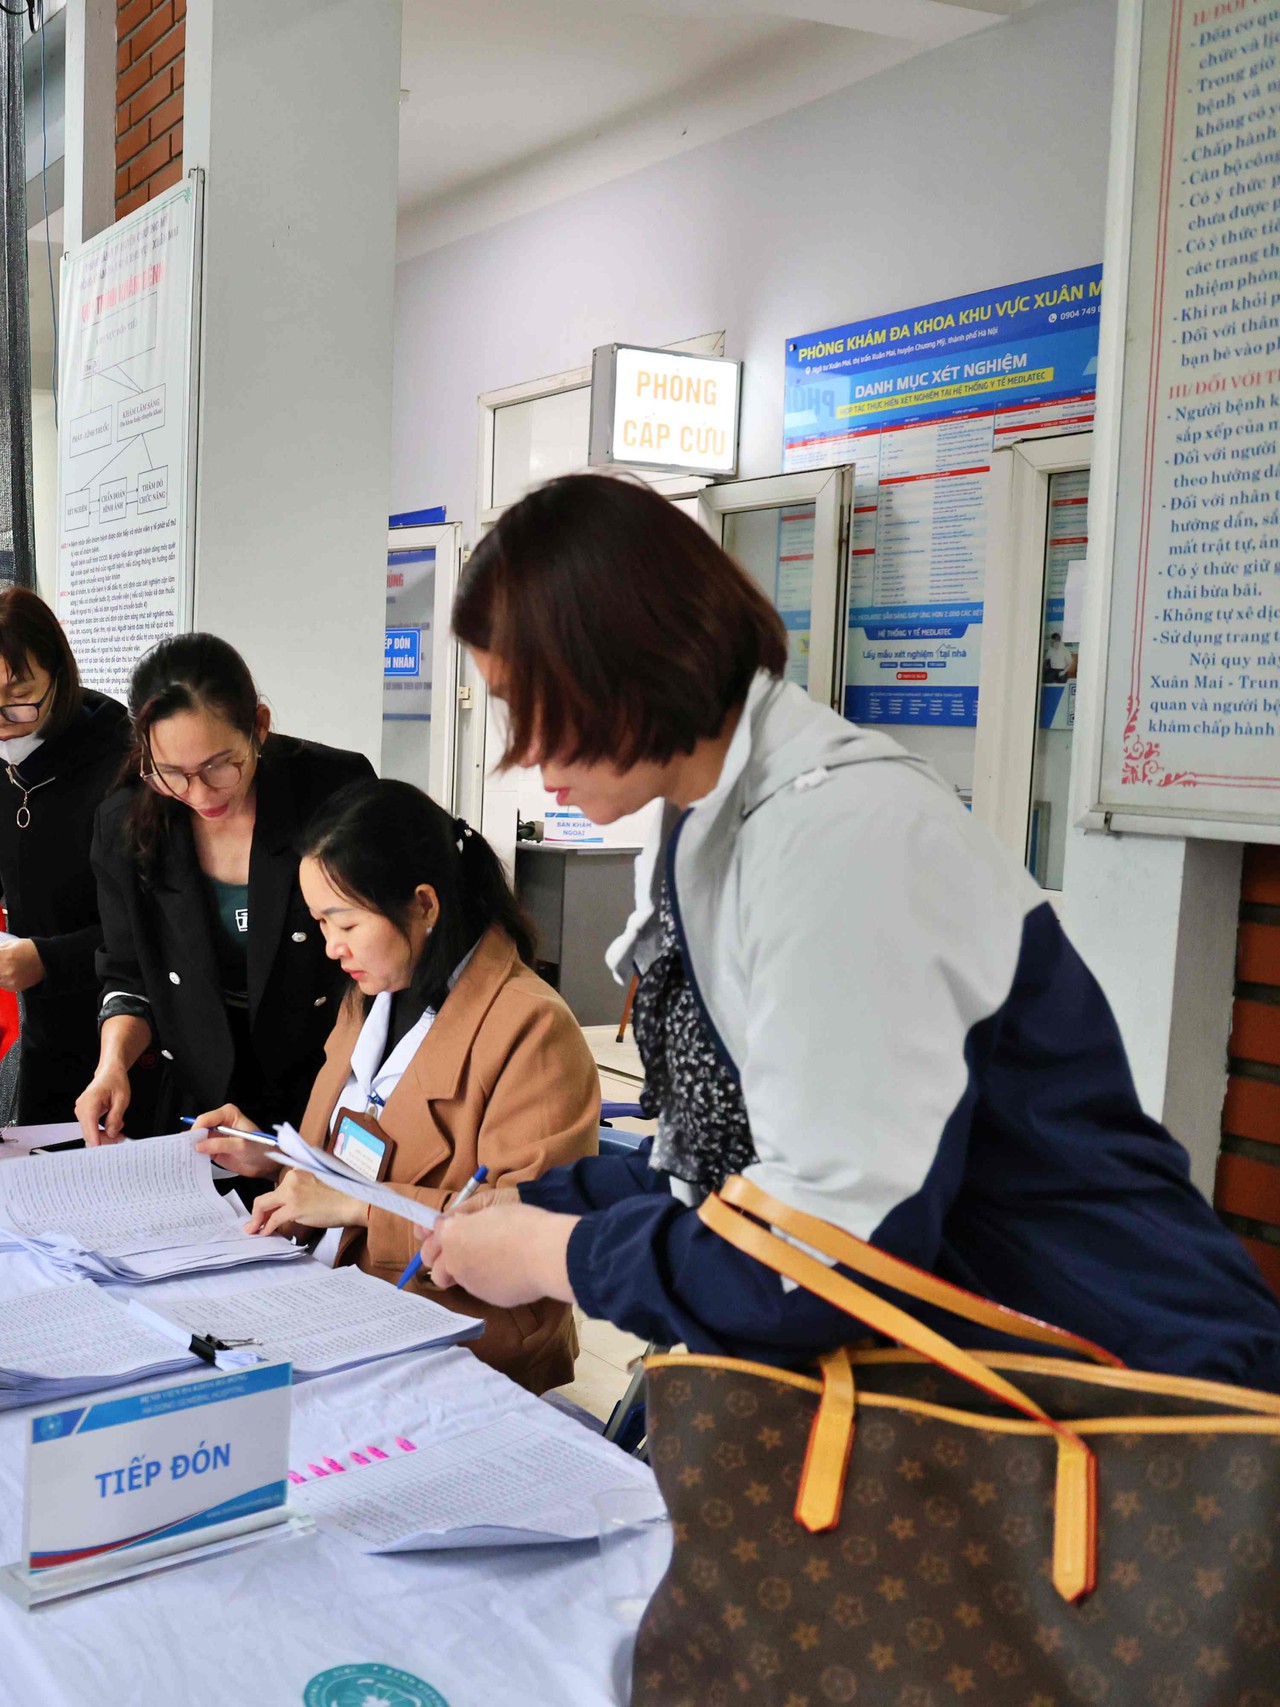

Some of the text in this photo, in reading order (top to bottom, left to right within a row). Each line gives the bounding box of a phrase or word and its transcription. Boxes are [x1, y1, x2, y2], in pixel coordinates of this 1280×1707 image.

[1199, 38, 1259, 69] chức và
[1197, 55, 1277, 92] Trong giờ
[1197, 83, 1261, 116] bệnh và
[1195, 105, 1266, 139] không có
[1191, 126, 1277, 162] Chấp hành
[1223, 158, 1241, 177] bộ
[1229, 179, 1266, 197] thức
[1188, 201, 1270, 231] chưa được
[1222, 224, 1258, 245] thức
[1186, 251, 1259, 277] các trang
[1185, 279, 1234, 300] nhiệm
[1060, 310, 1080, 321] 0904
[1082, 306, 1097, 316] 749
[1181, 304, 1208, 322] Khi
[1212, 304, 1228, 316] ra
[798, 339, 844, 362] PHÒNG
[847, 329, 887, 351] KHÁM
[889, 325, 911, 341] ĐA
[914, 313, 956, 336] KHOA
[959, 305, 992, 326] KHU
[995, 296, 1030, 318] VỰC
[1034, 284, 1084, 309] XUÂN
[1212, 321, 1236, 338] với
[1241, 315, 1279, 334] thân
[978, 329, 987, 337] Hà
[1181, 342, 1262, 369] bạn bè vào
[855, 353, 1028, 399] DANH MỤC XÉT NGHIỆM
[964, 380, 988, 394] THỐNG
[997, 376, 1006, 387] TẾ
[1007, 371, 1046, 386] MEDLATEC
[1231, 370, 1261, 389] VỚI
[1176, 395, 1266, 421] Người bệnh
[1175, 418, 1265, 444] sắp xếp của
[1204, 446, 1227, 462] với
[1231, 440, 1276, 461] người
[1173, 468, 1261, 488] theo hướng
[1202, 493, 1225, 508] với
[1230, 489, 1271, 506] nhân
[1171, 518, 1220, 533] hướng
[1169, 538, 1198, 555] mất
[1201, 537, 1230, 556] trật
[1203, 561, 1239, 576] thức
[1243, 559, 1271, 576] giữ
[1167, 585, 1197, 600] thải
[1200, 584, 1229, 599] bừa
[1162, 605, 1254, 624] Không tự xê
[394, 635, 411, 650] ĐÓN
[1182, 630, 1222, 647] dụng
[1226, 632, 1271, 645] trang
[392, 654, 415, 668] NHÂN
[907, 649, 934, 660] nghiệm
[1189, 652, 1251, 669] Nội quy
[1150, 674, 1189, 689] Xuân
[1194, 675, 1223, 689] Mai
[1150, 698, 1257, 714] quan và người
[1149, 719, 1275, 737] khám chấp hành
[95, 1440, 231, 1498] TIẾP ĐÓN
